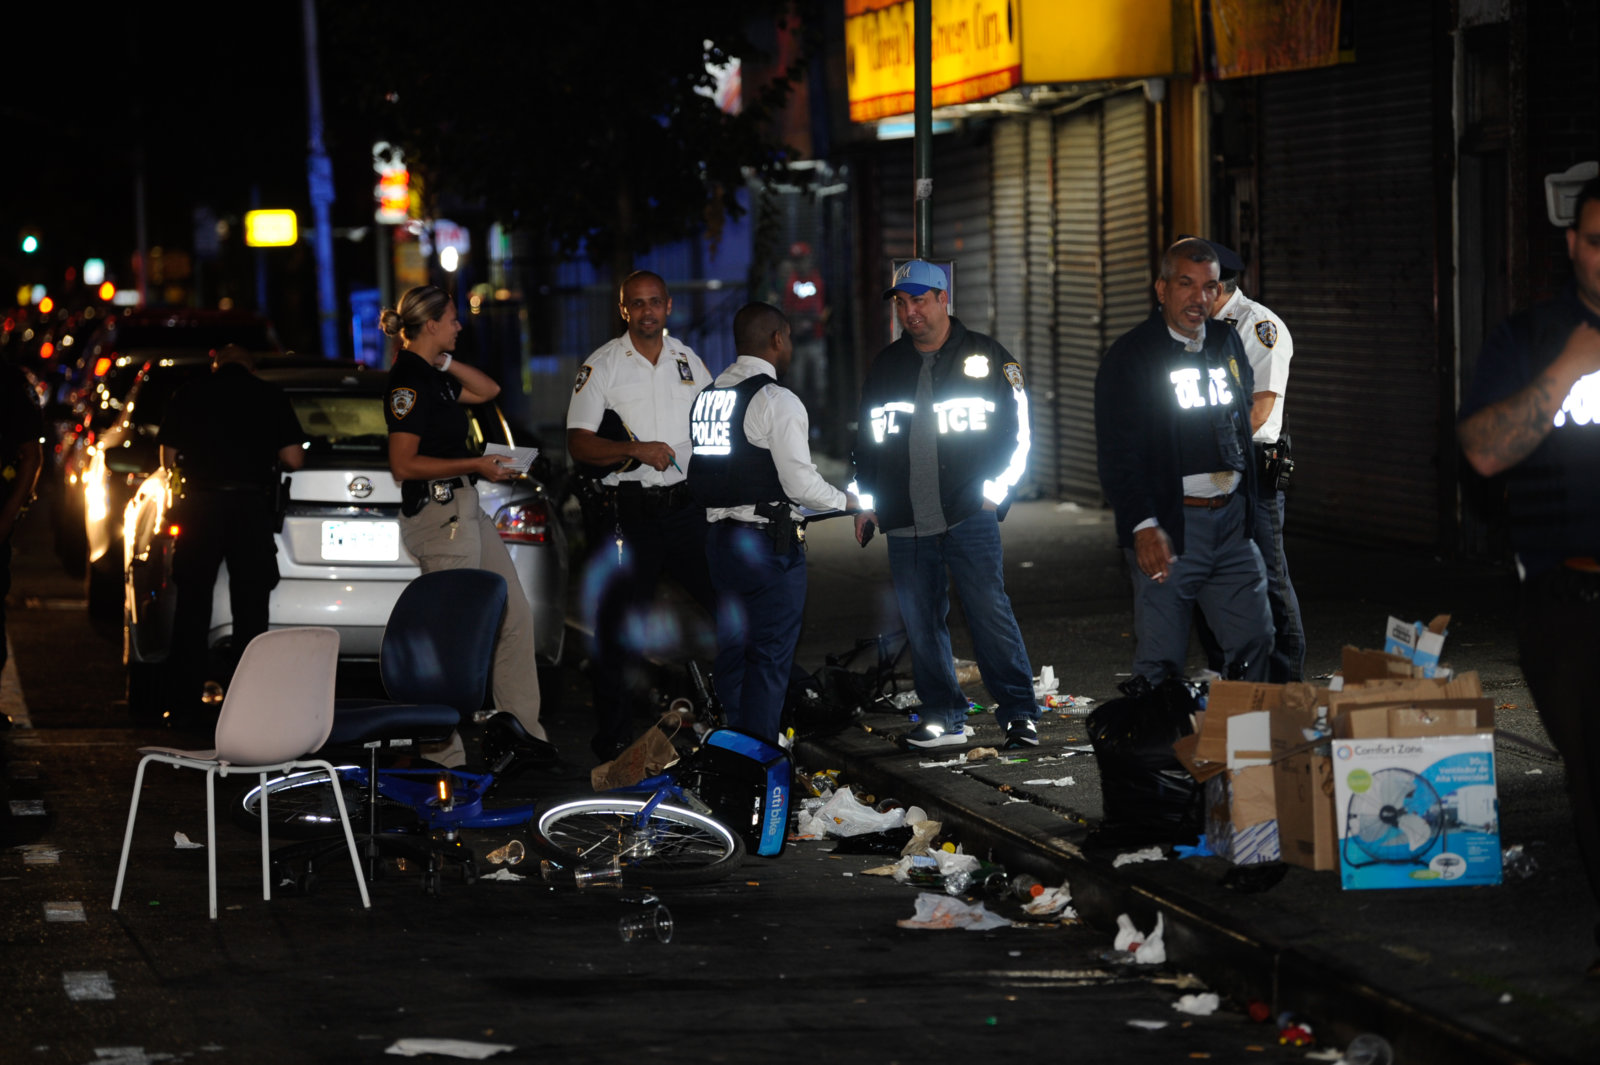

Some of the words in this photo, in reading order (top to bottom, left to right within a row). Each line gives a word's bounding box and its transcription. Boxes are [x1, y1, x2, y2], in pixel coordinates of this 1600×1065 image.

[692, 390, 737, 421] NYPD
[692, 421, 731, 446] POLICE
[1354, 743, 1396, 756] Comfort
[1398, 743, 1424, 754] Zone
[772, 786, 784, 808] citi
[769, 808, 782, 836] bike
